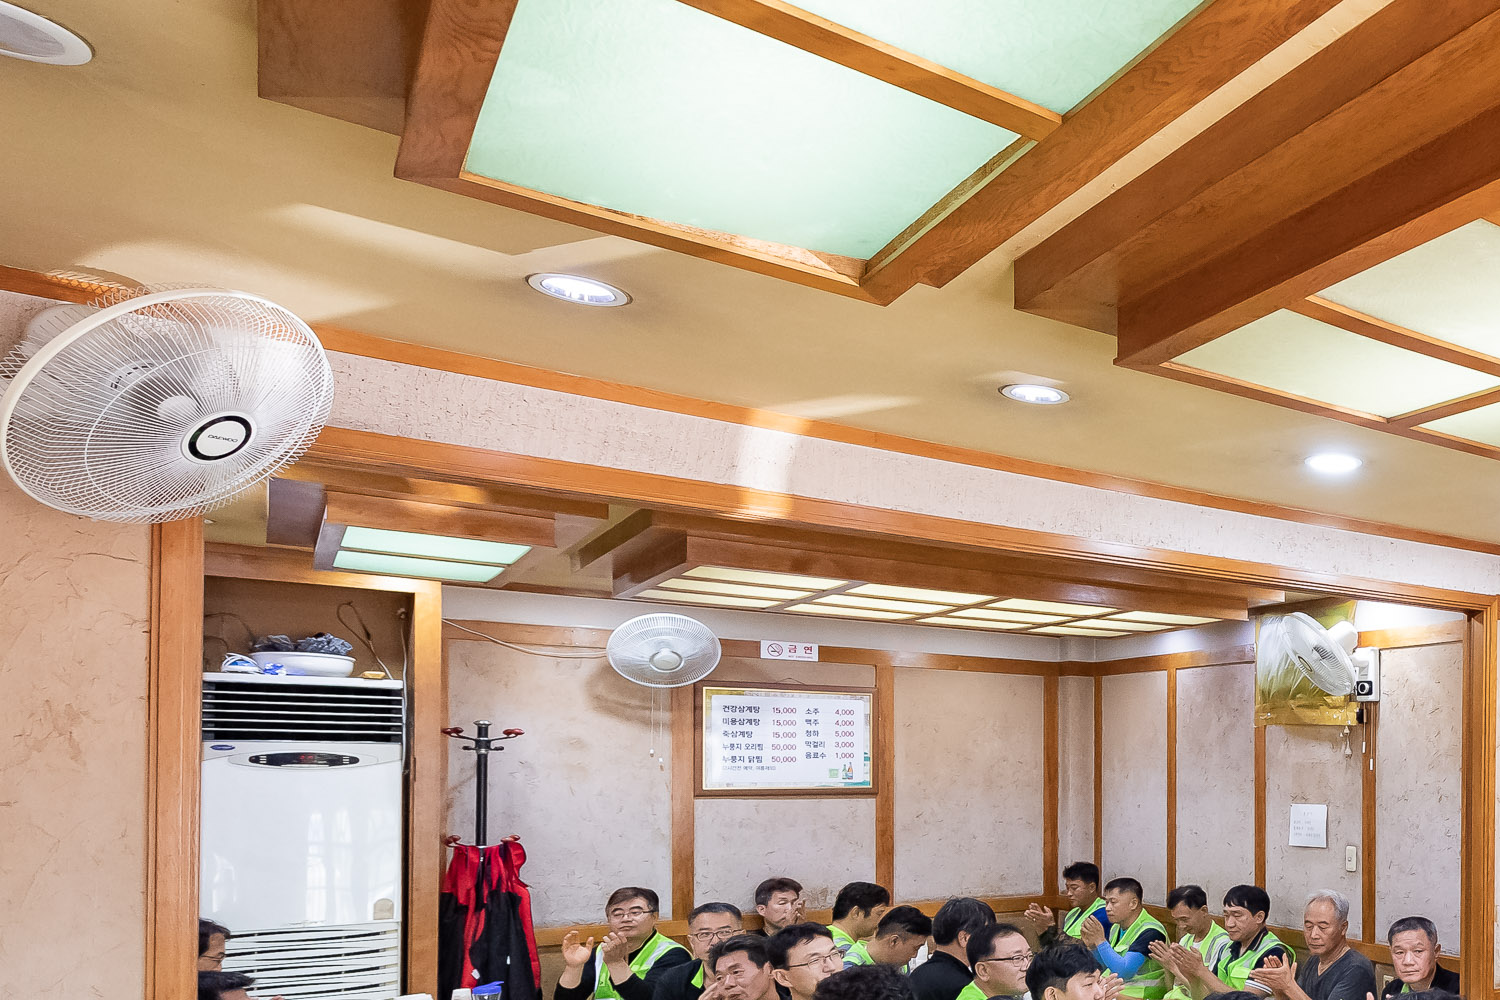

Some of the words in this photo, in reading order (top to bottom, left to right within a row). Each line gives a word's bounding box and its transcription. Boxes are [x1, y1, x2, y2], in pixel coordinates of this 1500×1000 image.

[722, 705, 760, 714] 건강삼계탕
[805, 708, 820, 716] 소주
[772, 719, 797, 727] 15,000
[805, 719, 820, 727] 맥주
[835, 719, 855, 727] 4,000
[772, 731, 797, 739] 15,000
[805, 729, 819, 738] 청하
[835, 730, 855, 738] 5,000
[771, 743, 797, 751] 50,000
[805, 740, 826, 749] 막걸리
[835, 741, 855, 749] 3,000
[805, 751, 827, 760] 음료수
